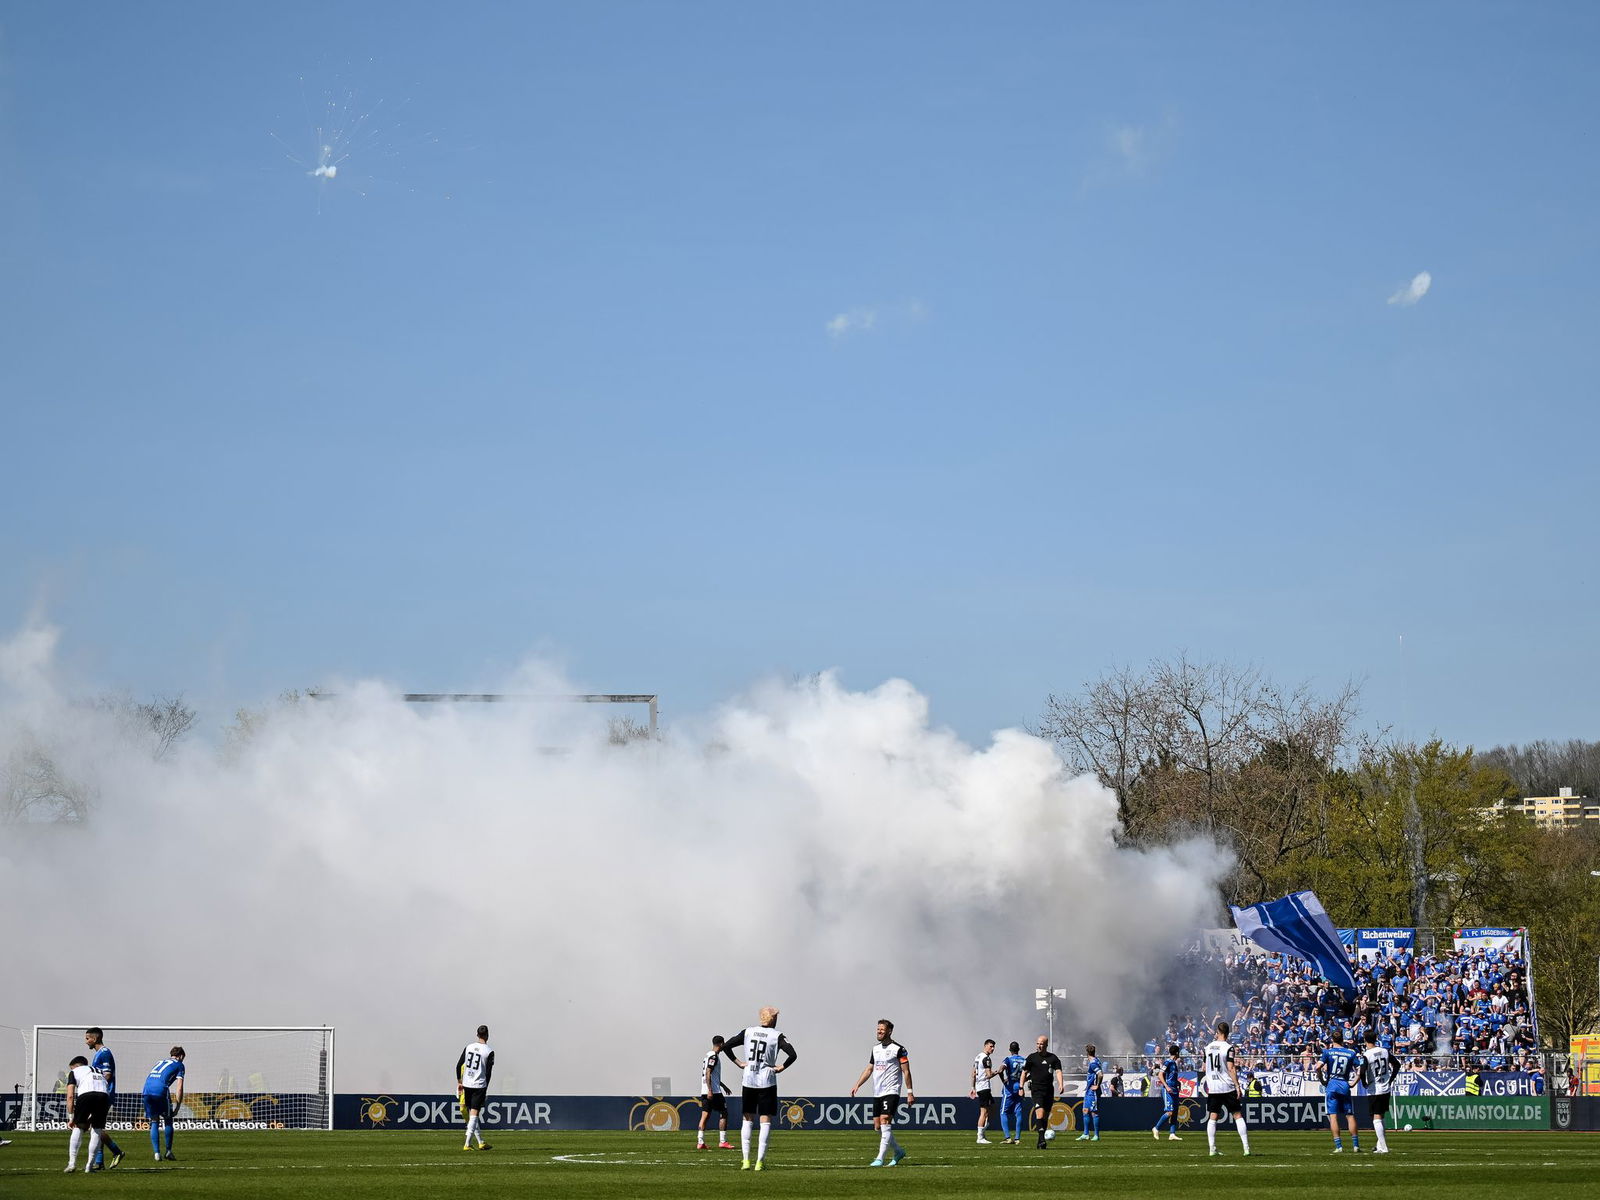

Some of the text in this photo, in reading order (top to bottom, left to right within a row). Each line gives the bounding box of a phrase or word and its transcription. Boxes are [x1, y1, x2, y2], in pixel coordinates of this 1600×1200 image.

[1362, 930, 1411, 939] Eichenweiler
[466, 1051, 481, 1070] 33
[1208, 1052, 1221, 1072] 14
[1331, 1055, 1348, 1075] 13
[1419, 1088, 1466, 1096] FAN CLUB
[882, 1100, 888, 1110] 5
[1389, 1104, 1542, 1121] WWW.TEAMSTOLZ.DE
[814, 1104, 957, 1125] JOKESTAR
